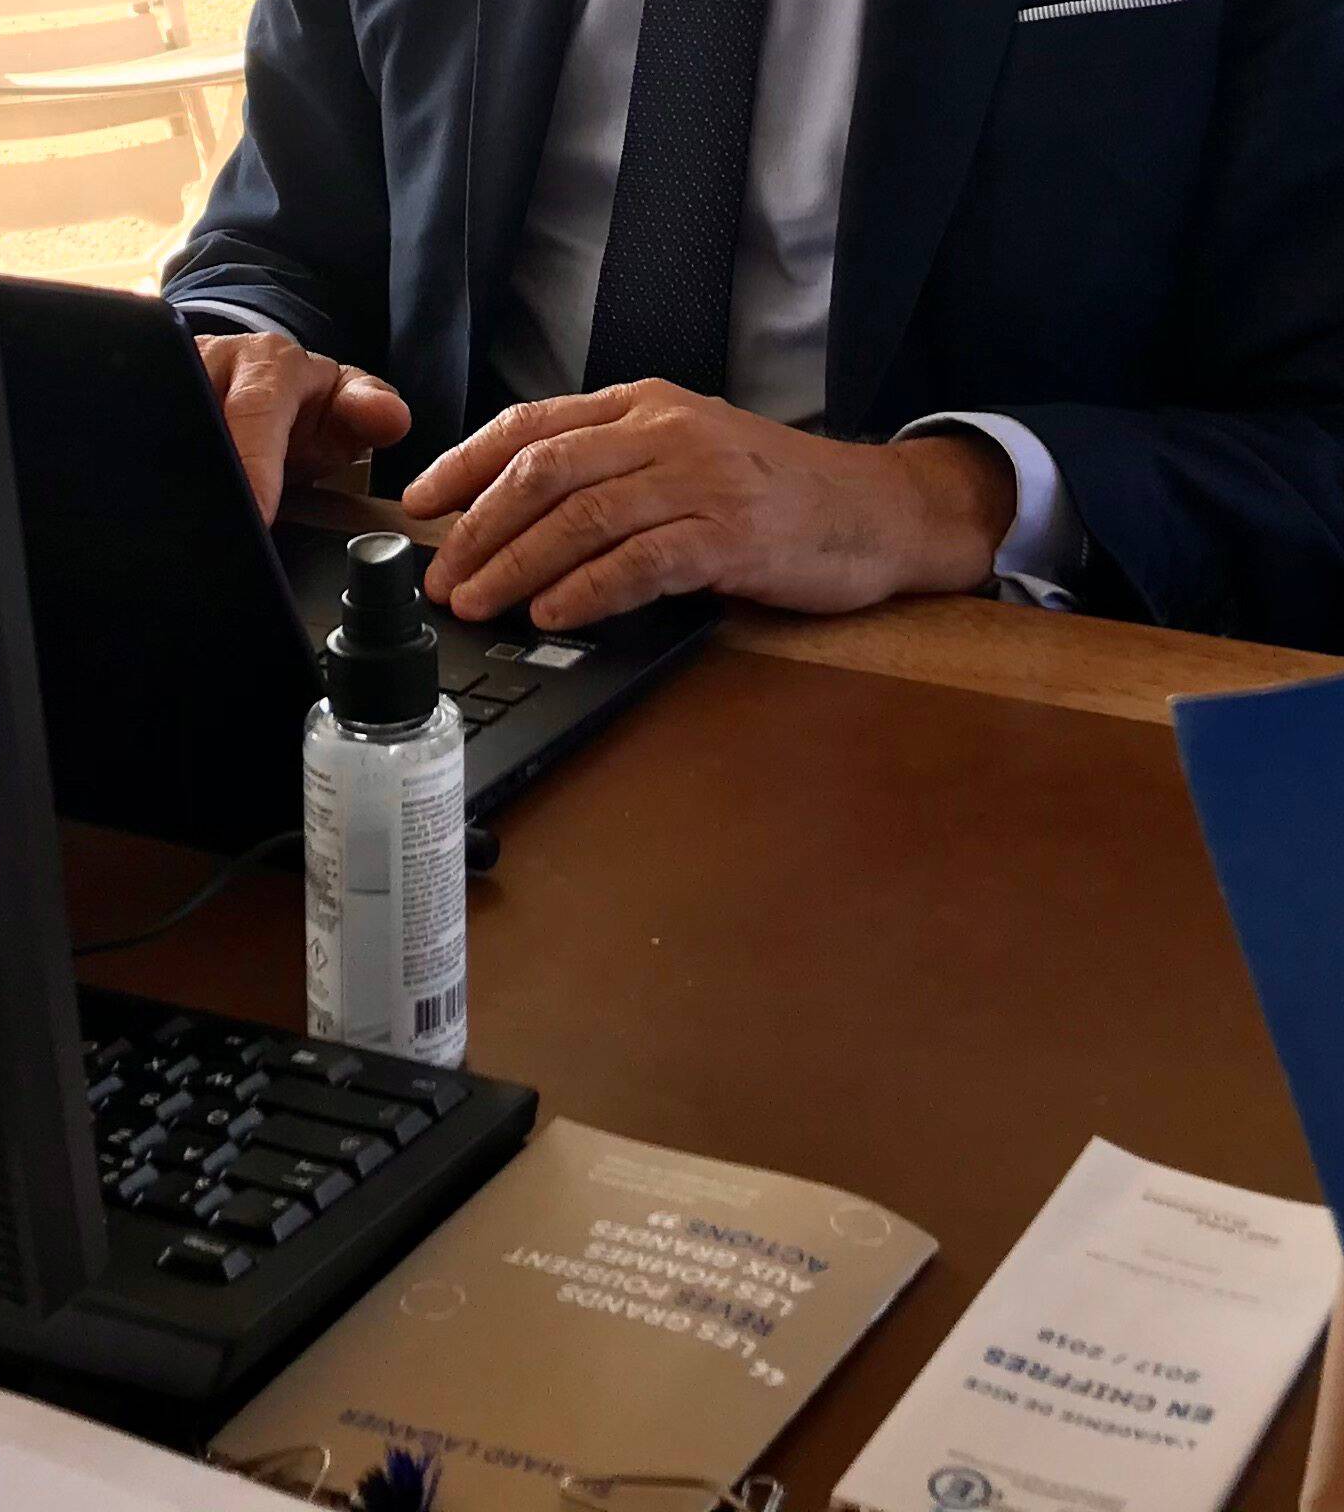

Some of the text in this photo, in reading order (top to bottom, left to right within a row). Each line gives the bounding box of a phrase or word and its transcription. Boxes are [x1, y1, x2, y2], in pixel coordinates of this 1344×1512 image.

[590, 1218, 816, 1294] AUX GRANDES
[688, 1217, 830, 1273] ACTIONS
[502, 1246, 672, 1301] POUSSENT
[584, 1241, 796, 1317] LES HOMMES
[556, 1282, 757, 1359] LES GRANDS
[1036, 1326, 1105, 1361] 2018
[963, 1373, 1019, 1406] NICE
[982, 1344, 1217, 1425] EN CHIFFRES
[1133, 1359, 1201, 1385] 2017
